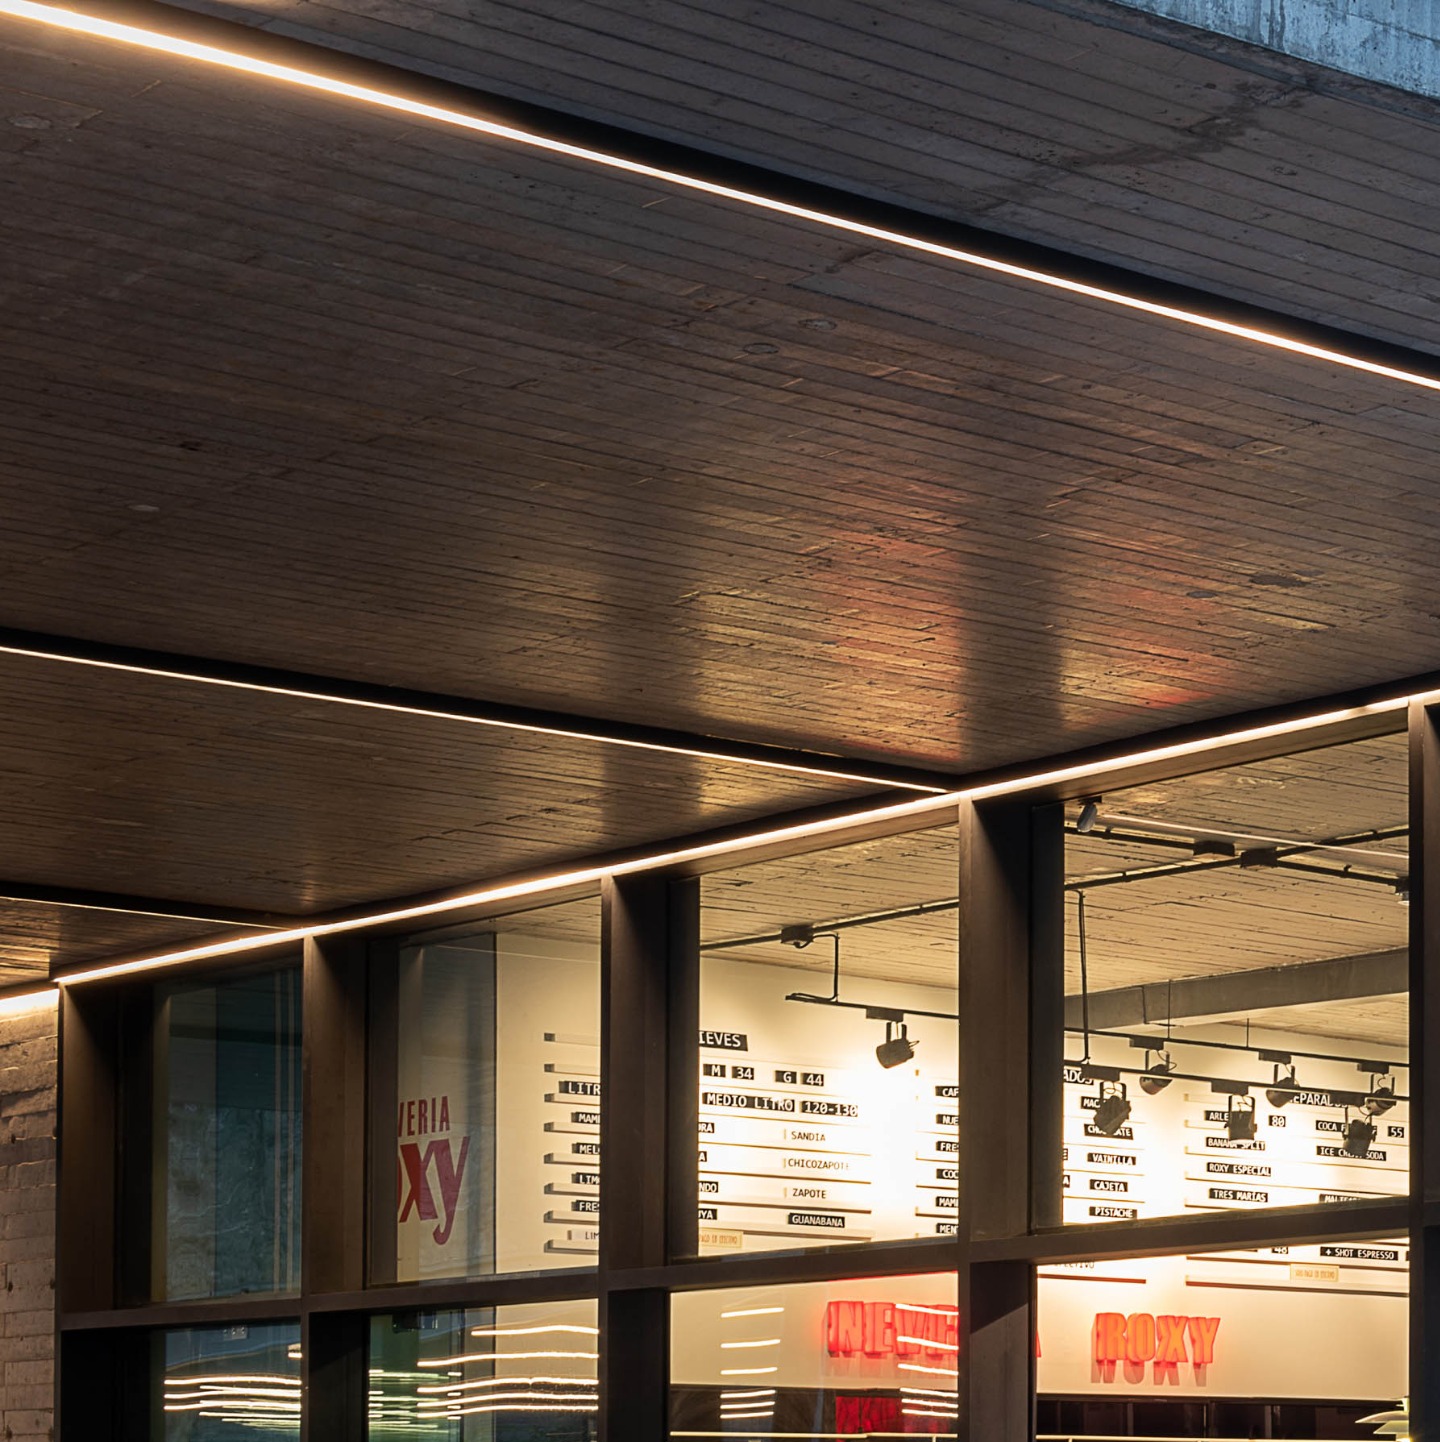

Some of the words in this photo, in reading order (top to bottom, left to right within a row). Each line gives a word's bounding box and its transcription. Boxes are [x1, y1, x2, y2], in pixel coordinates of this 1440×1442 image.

[699, 1031, 741, 1048] IEVES
[711, 1065, 721, 1077] M
[736, 1067, 753, 1080] 34
[783, 1072, 792, 1083] G
[806, 1074, 823, 1086] 44
[568, 1081, 600, 1096] LITR
[707, 1093, 747, 1107] MEDIO
[754, 1097, 793, 1112] LITRO
[805, 1101, 858, 1117] 120-130
[942, 1088, 959, 1098] CAF
[578, 1113, 600, 1124] MAM
[1209, 1112, 1229, 1121] ARLE
[1271, 1116, 1285, 1127] 80
[1317, 1122, 1338, 1132] COCA
[1390, 1127, 1404, 1138] 55
[579, 1144, 600, 1154] MEL
[1320, 1148, 1334, 1156] ICE
[1366, 1151, 1384, 1160] SODA
[1209, 1164, 1229, 1173] ROXY
[1233, 1165, 1271, 1177] ESPECIAL
[1094, 1181, 1125, 1192] CAJETA
[792, 1188, 827, 1199] ZAPOTE
[1214, 1190, 1233, 1200] TRES
[1094, 1207, 1134, 1218] PISTACHE
[792, 1215, 844, 1228] GUANABANA
[1335, 1248, 1354, 1258] SHOT
[1358, 1250, 1394, 1260] ESPRESSO
[1096, 1312, 1221, 1364] ROXY
